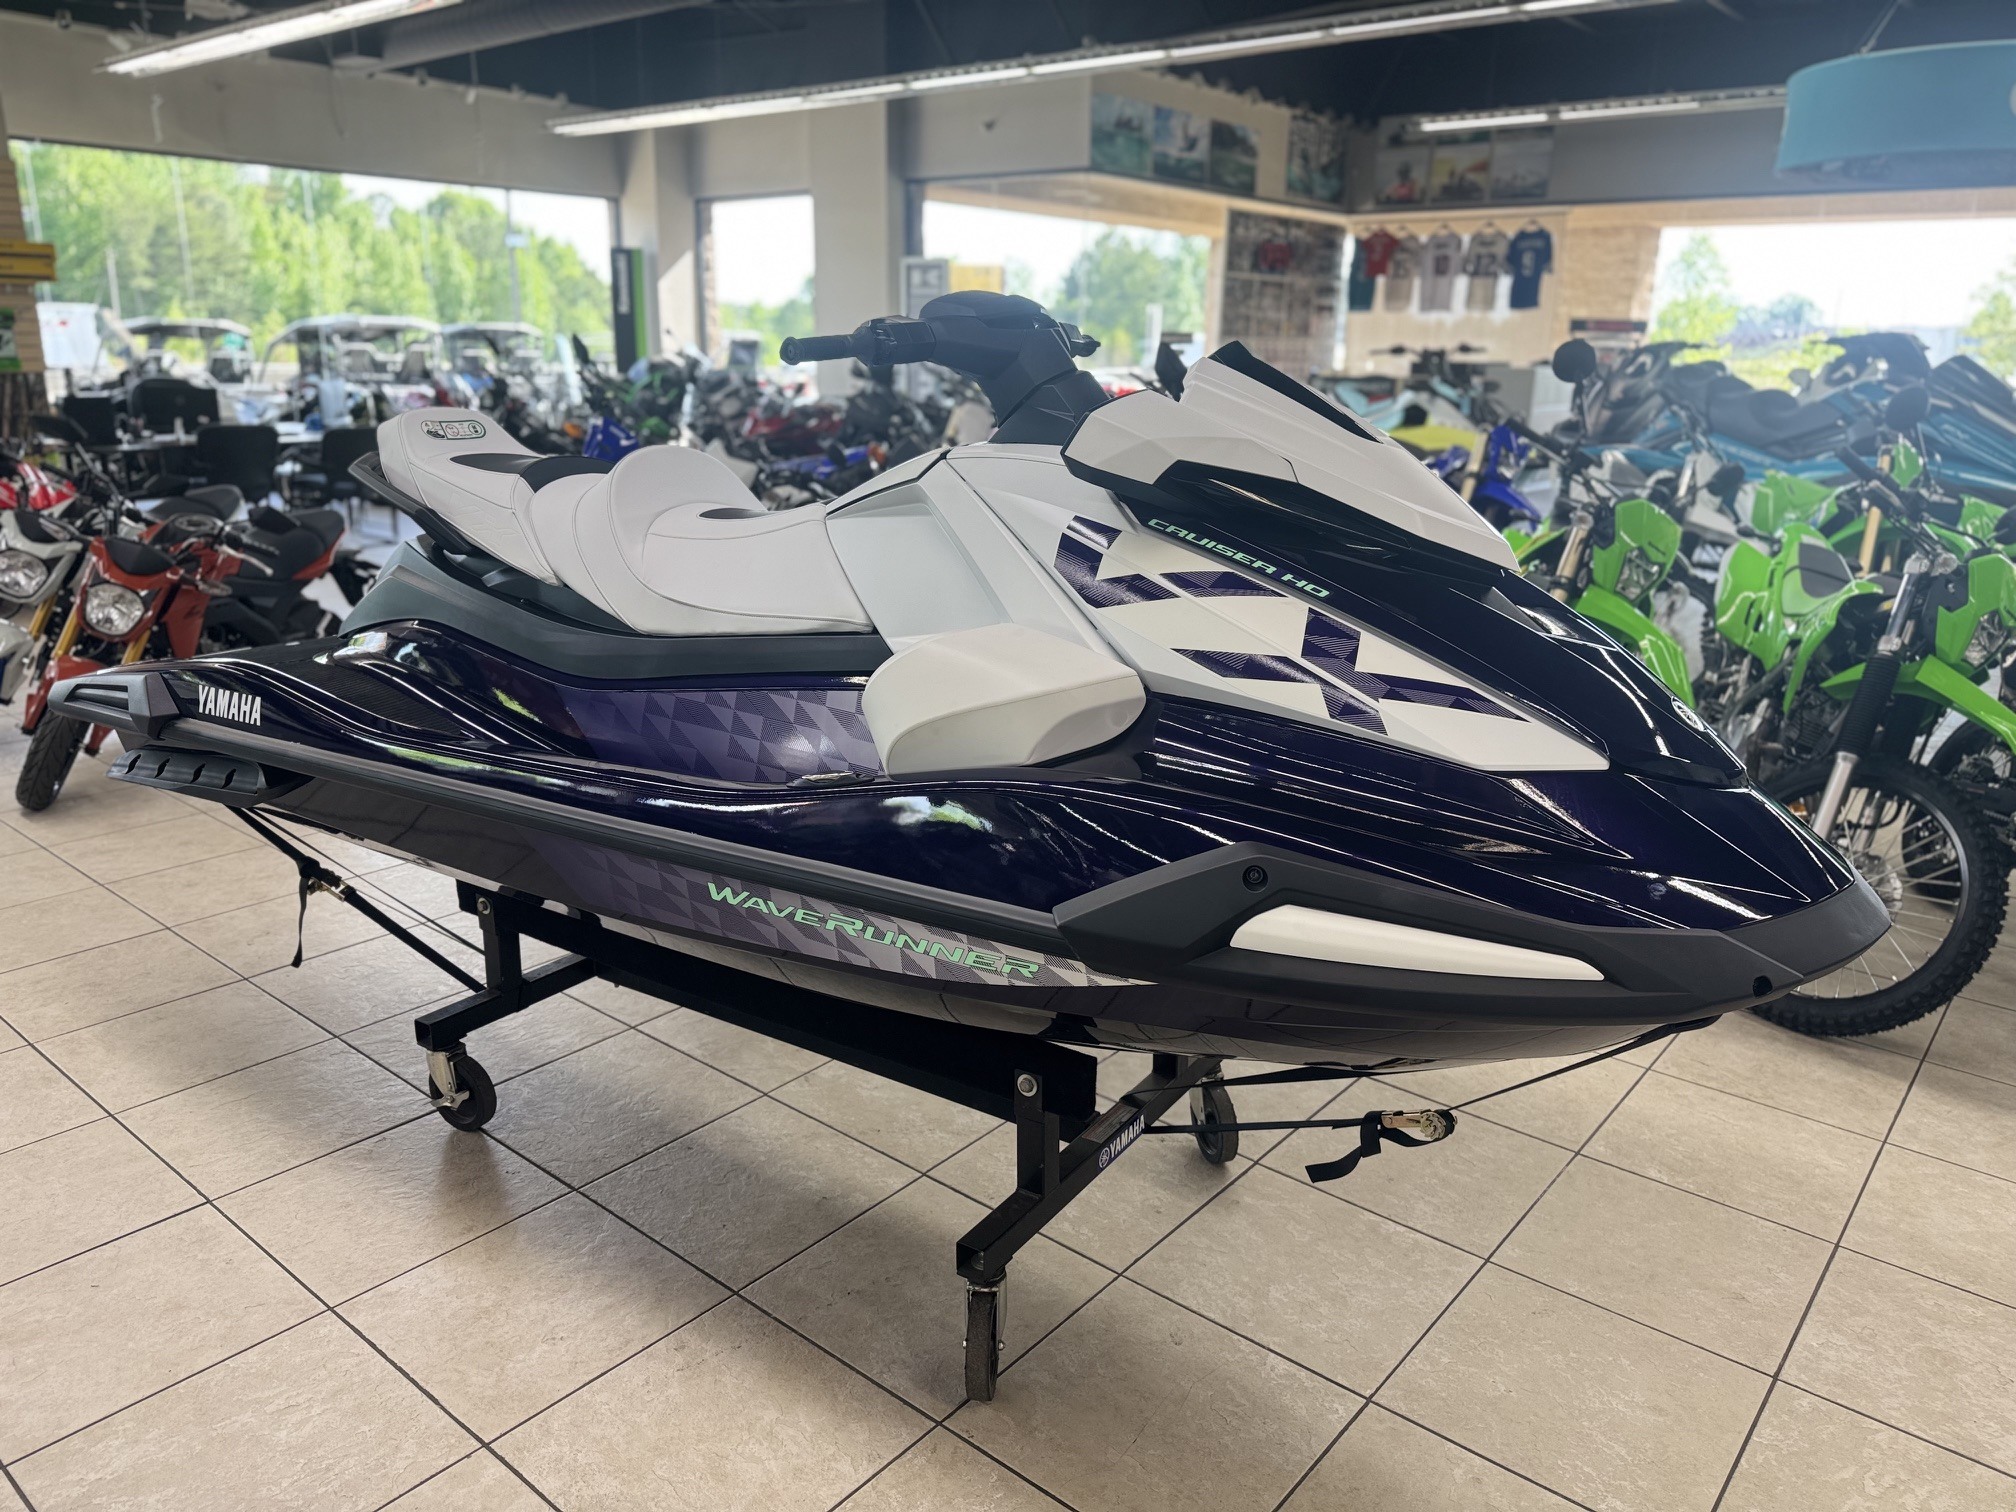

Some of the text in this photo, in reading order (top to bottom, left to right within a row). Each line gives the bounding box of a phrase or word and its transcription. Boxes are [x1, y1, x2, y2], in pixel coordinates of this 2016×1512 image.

[1148, 518, 1330, 598] CRUISER HO
[198, 684, 262, 727] YAMAHA
[1109, 1114, 1146, 1158] YAMAHA
